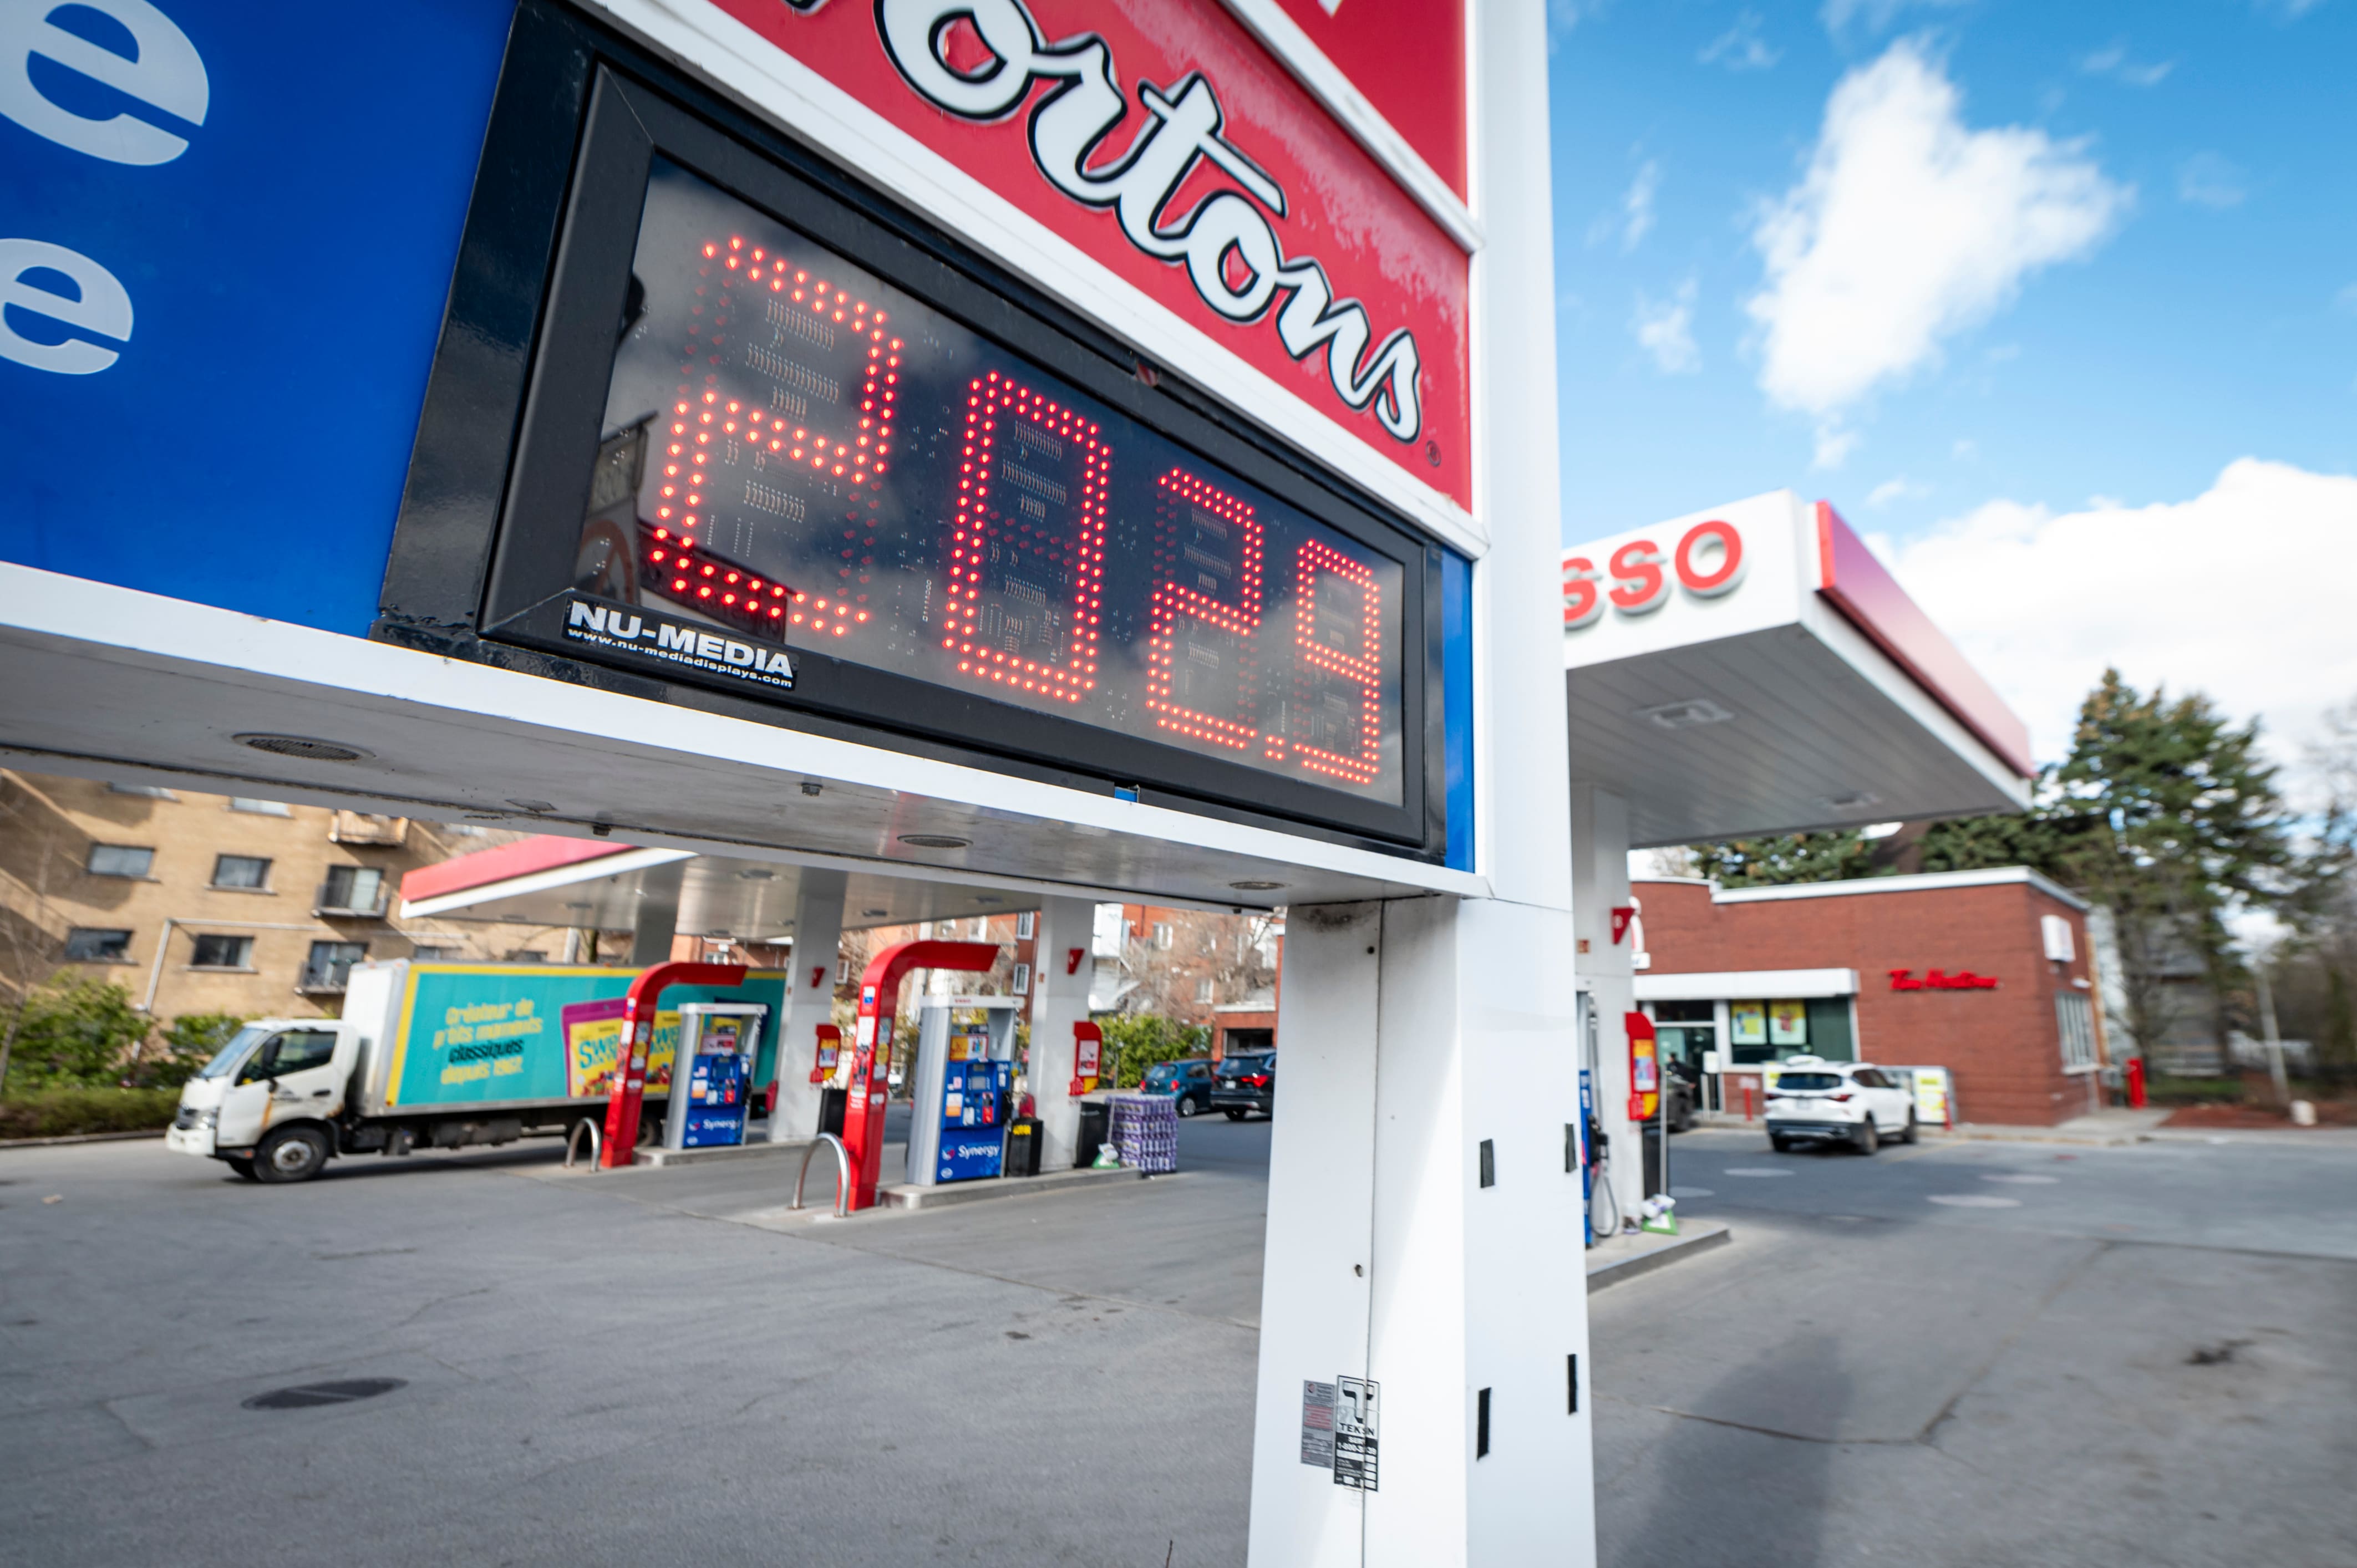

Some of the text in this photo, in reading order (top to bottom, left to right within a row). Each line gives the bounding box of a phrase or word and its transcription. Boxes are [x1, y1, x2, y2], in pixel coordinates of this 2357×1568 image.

[783, 0, 1421, 444] ortons
[569, 600, 794, 678] NU-MEDIA
[651, 234, 1380, 786] 202.9
[567, 628, 793, 688] www.nu-mediadisplays.com
